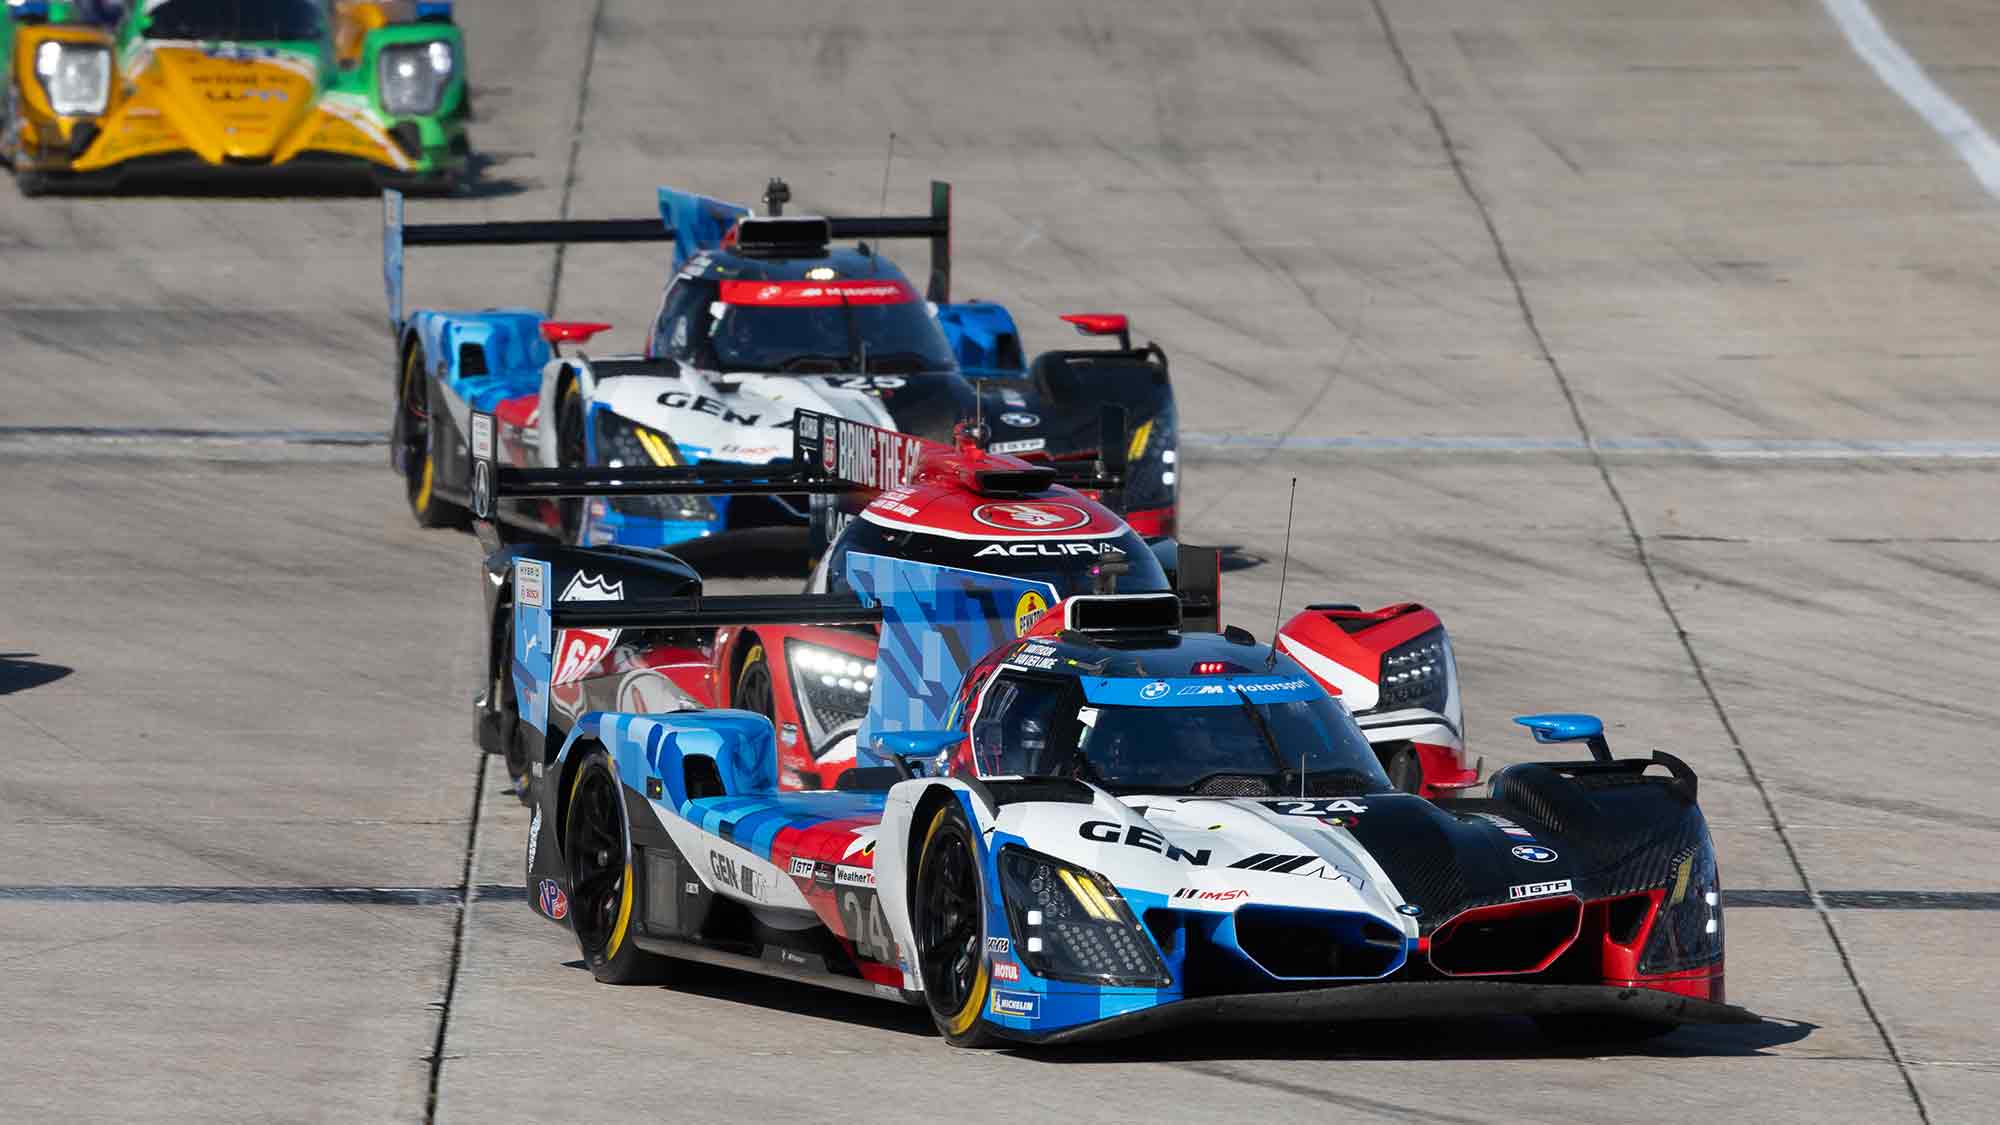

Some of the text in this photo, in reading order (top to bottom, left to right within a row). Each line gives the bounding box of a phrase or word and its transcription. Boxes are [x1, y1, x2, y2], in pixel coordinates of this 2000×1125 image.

[657, 391, 763, 427] GEN
[838, 420, 877, 488] BRING
[878, 430, 903, 491] THE
[973, 543, 1127, 558] ACURA
[1229, 680, 1310, 694] Motorsport
[1277, 799, 1370, 816] 24
[1078, 820, 1213, 867] GEN
[710, 850, 739, 891] GEN
[796, 861, 812, 875] GTP
[837, 867, 876, 884] WeatherTe
[1199, 889, 1250, 901] IMSA
[1528, 881, 1569, 894] GTP
[845, 891, 890, 961] 24
[994, 962, 1019, 979] MOTUL
[1000, 999, 1034, 1011] MICHELIN
